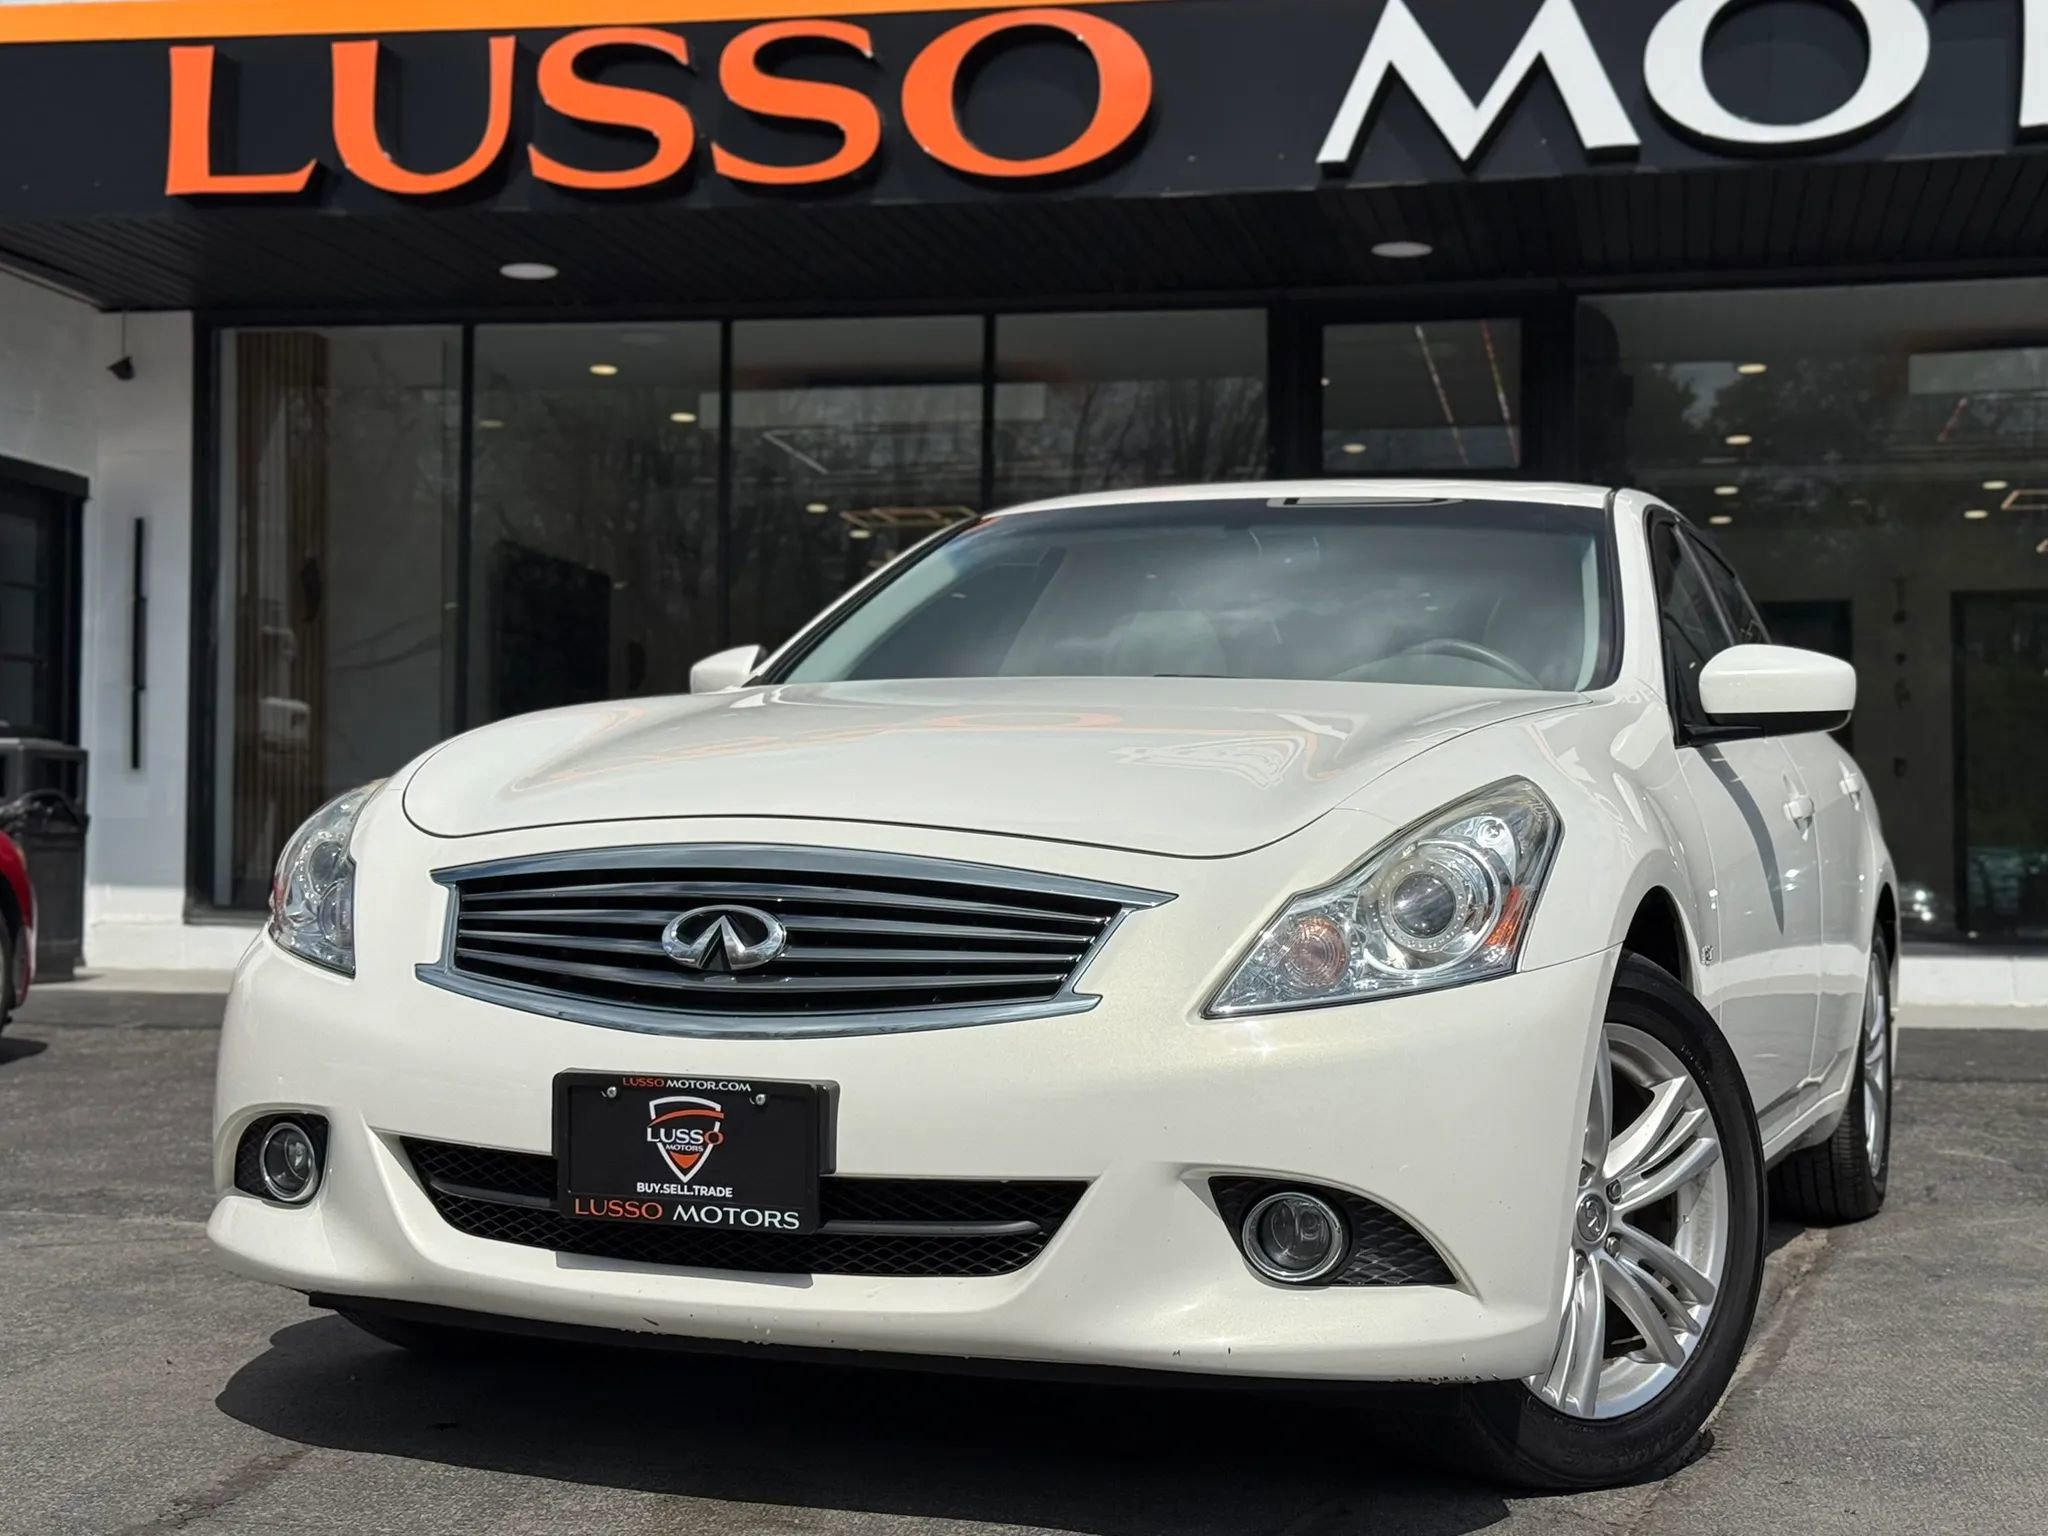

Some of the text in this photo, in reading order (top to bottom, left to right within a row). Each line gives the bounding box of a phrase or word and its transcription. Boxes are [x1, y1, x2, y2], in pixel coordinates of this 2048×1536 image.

[165, 0, 2048, 197] LUSSO MO
[646, 1127, 724, 1146] LUSSO
[665, 1143, 704, 1152] MOTORS
[574, 1198, 800, 1229] LUSSO MOTORS
